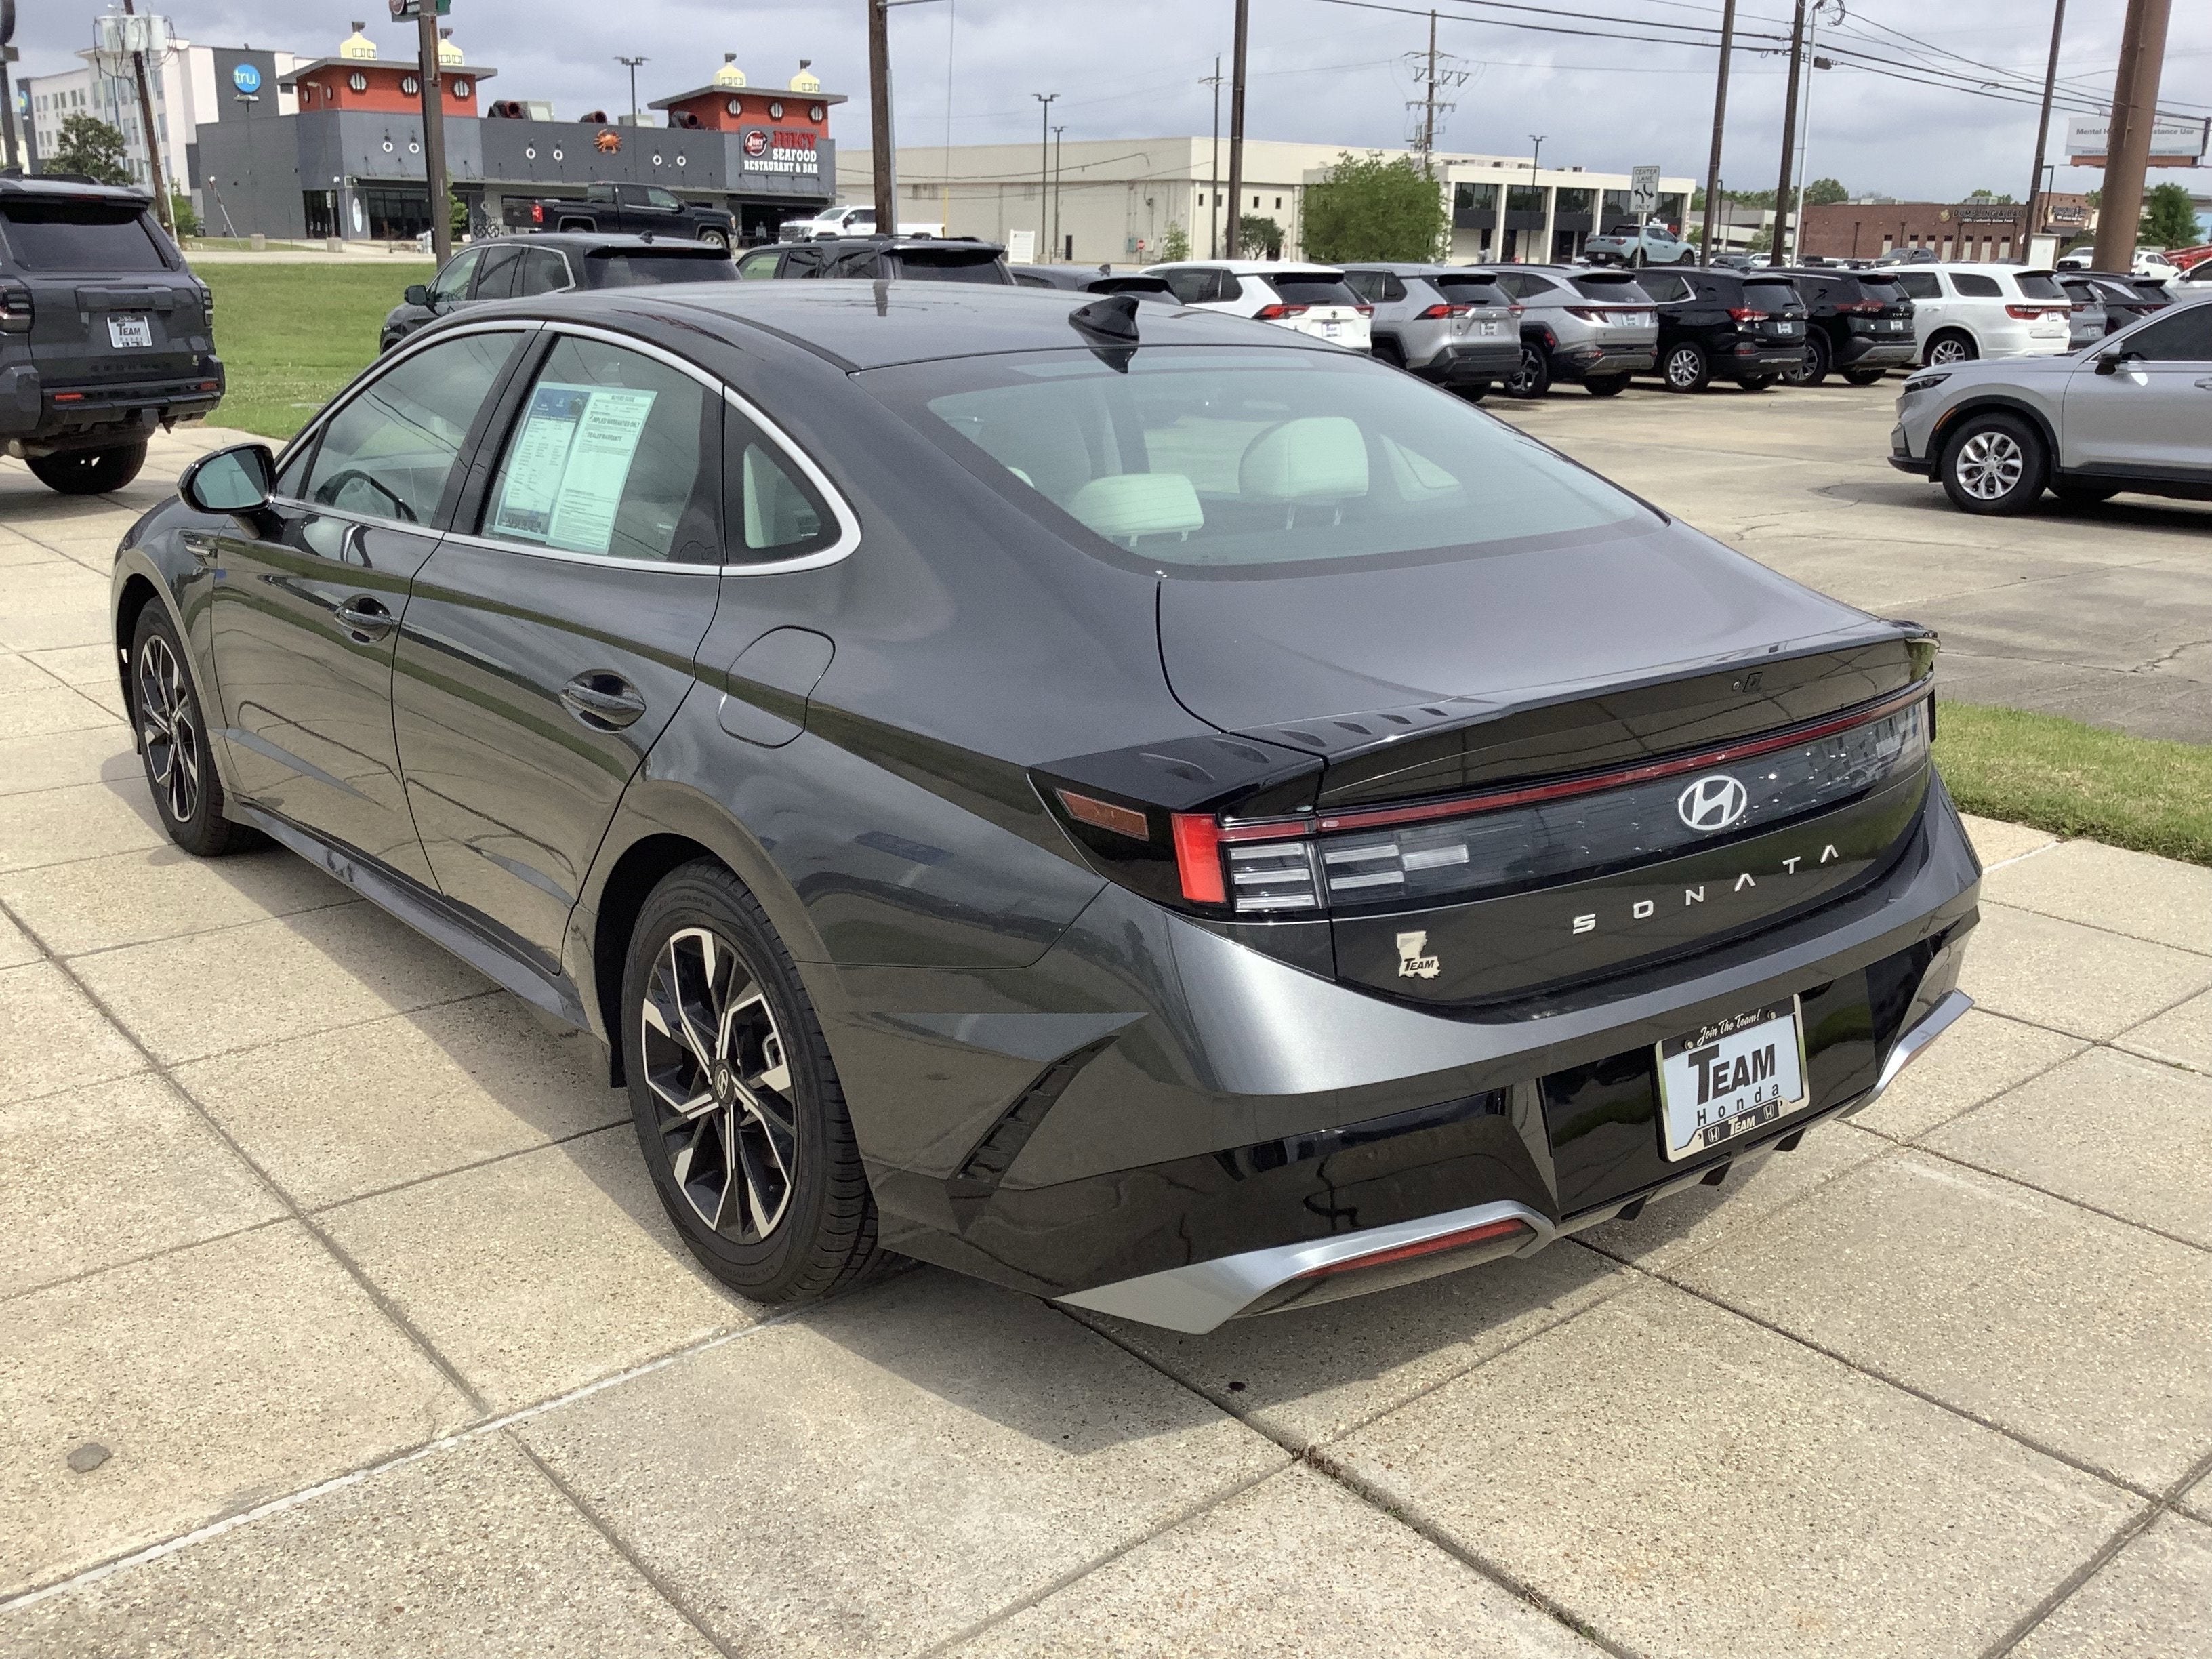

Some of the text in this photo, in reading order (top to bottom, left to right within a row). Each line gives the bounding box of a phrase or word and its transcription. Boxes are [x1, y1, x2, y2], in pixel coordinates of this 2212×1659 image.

[234, 70, 255, 84] tru
[770, 131, 817, 150] JUICY
[773, 148, 817, 162] SEAFOOD
[744, 160, 818, 173] RESTAURANT & BAR
[116, 323, 141, 336] TEAM
[1572, 844, 1839, 935] SONATA
[1404, 957, 1435, 972] TEAM
[1696, 1008, 1761, 1047] Join The Team!
[1687, 1043, 1776, 1107] TEAM
[1696, 1083, 1780, 1127] Honda
[1727, 1115, 1756, 1136] TEAM
